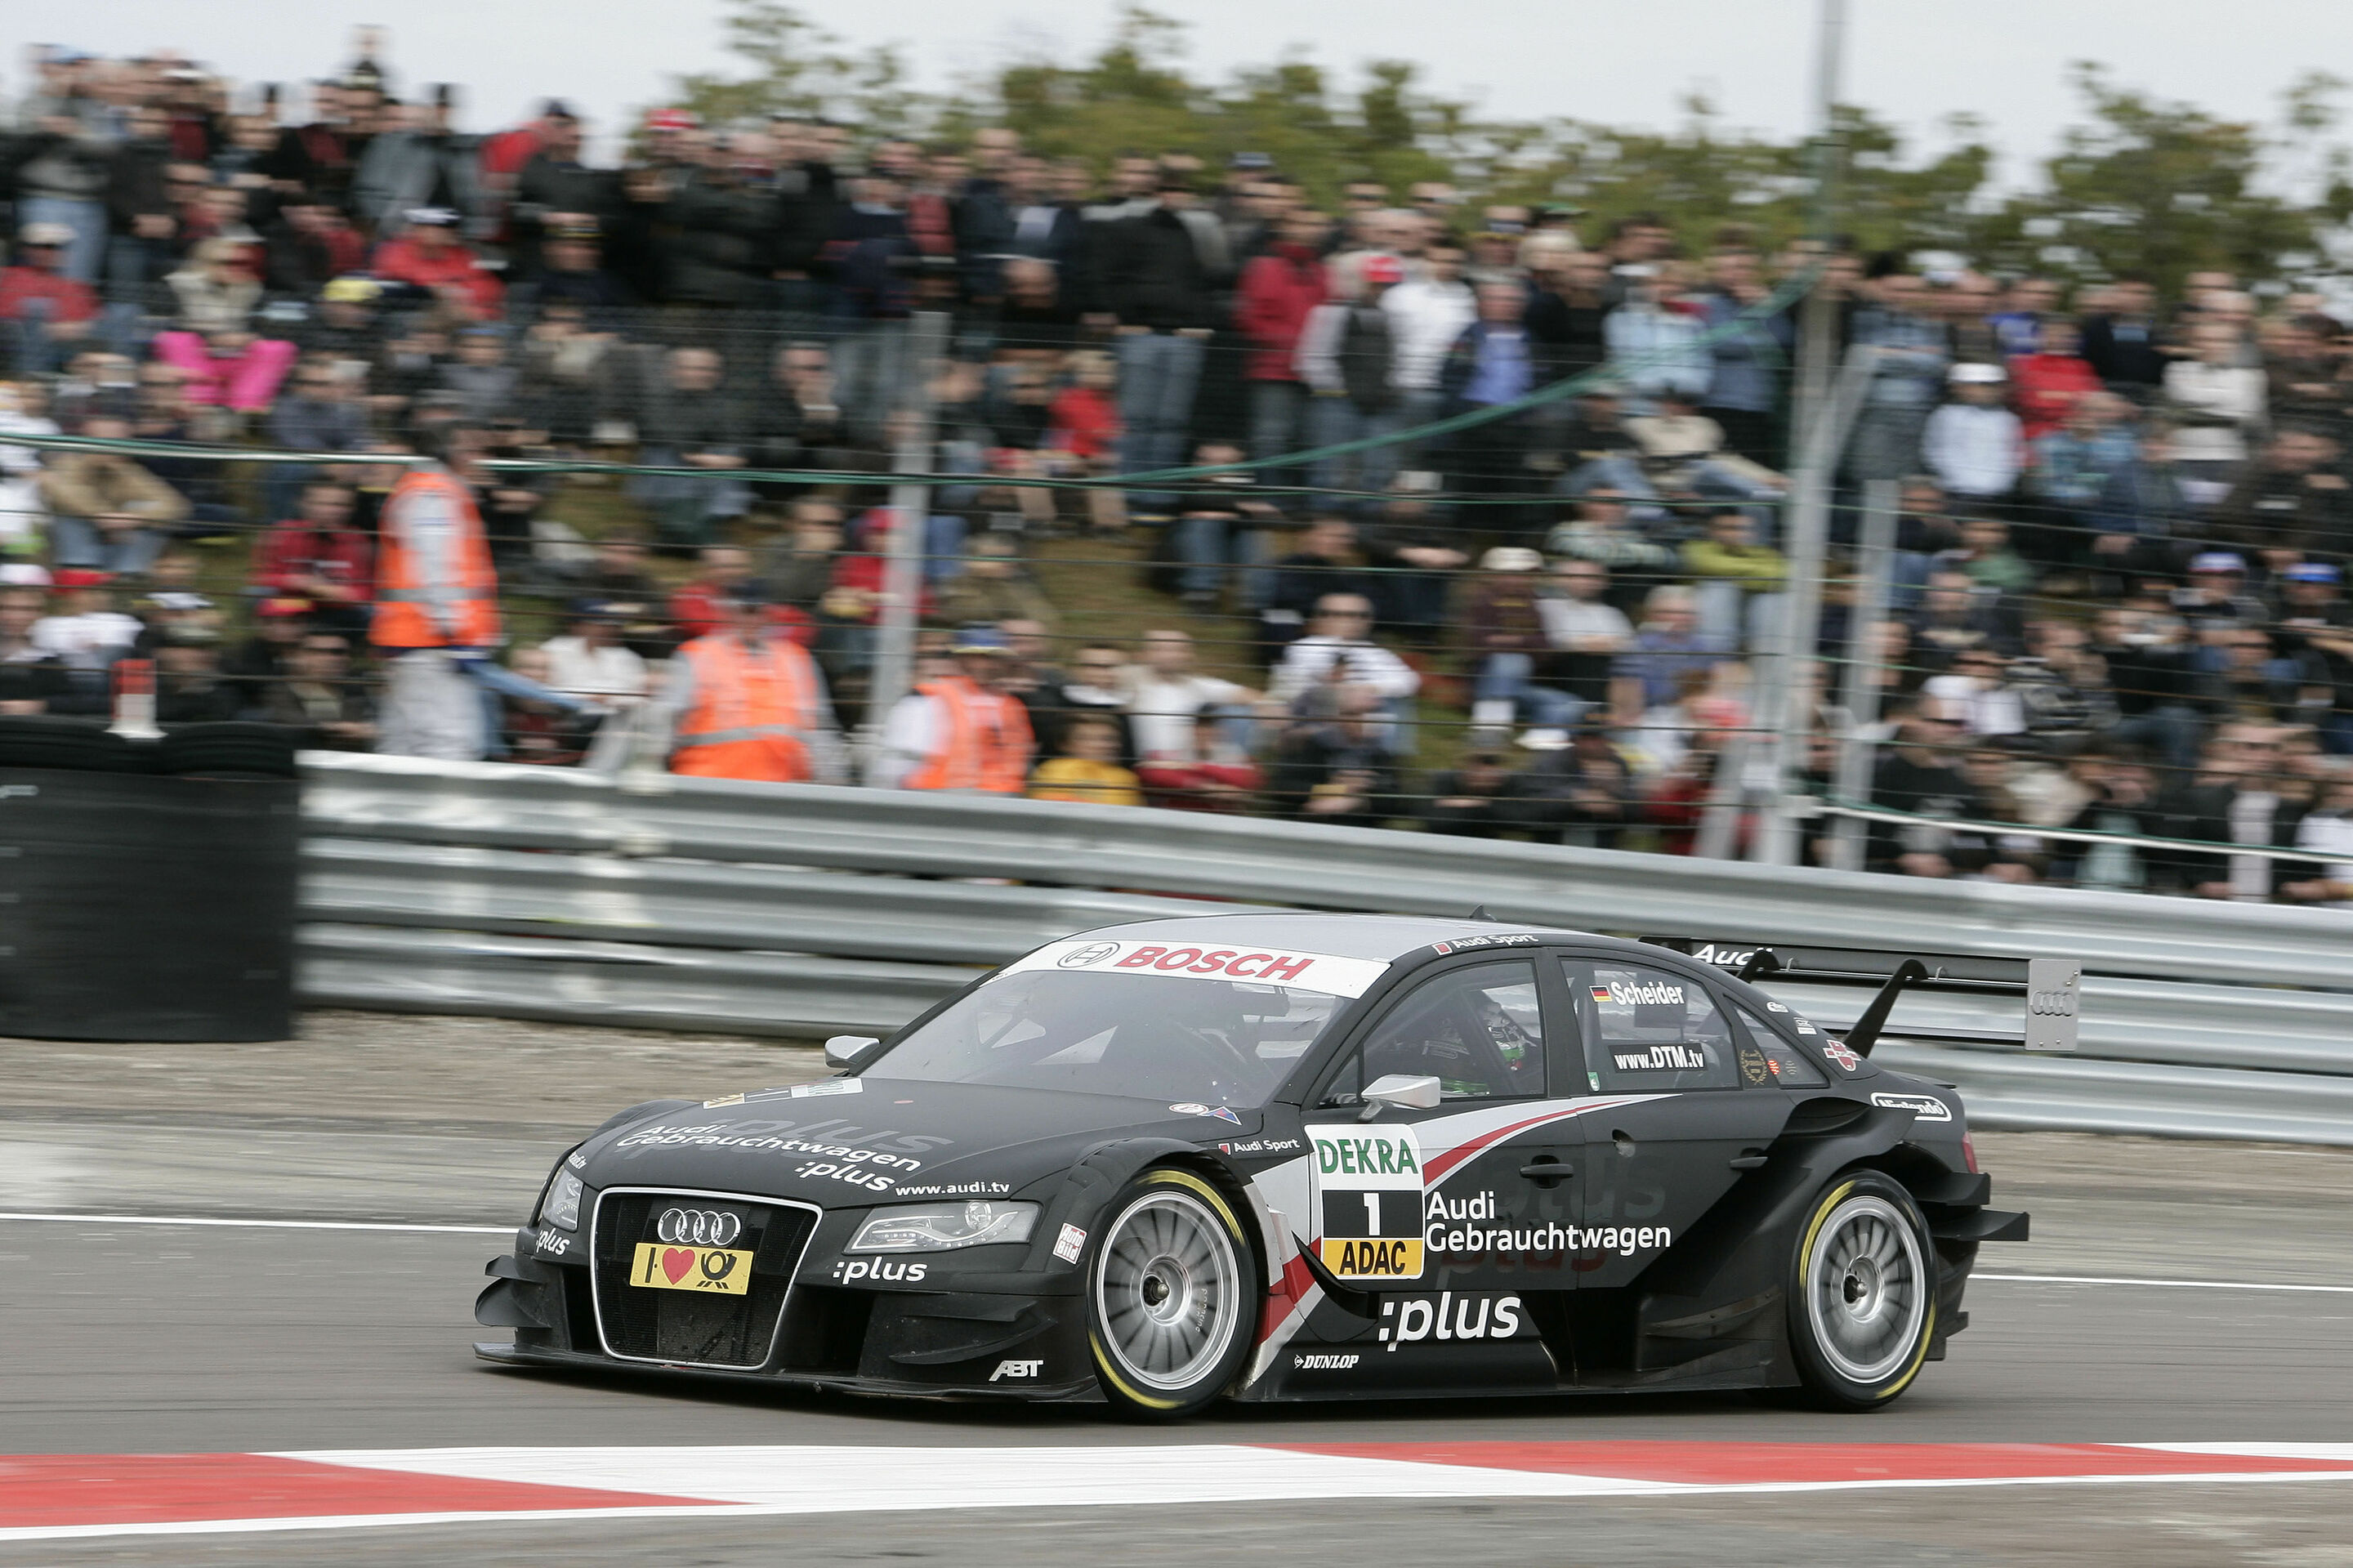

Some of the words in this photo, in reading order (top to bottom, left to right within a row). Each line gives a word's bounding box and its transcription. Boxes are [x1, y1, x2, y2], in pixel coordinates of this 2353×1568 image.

[1451, 936, 1491, 948] Audi
[1488, 935, 1539, 945] Sport
[1114, 946, 1315, 981] BOSCH
[1610, 981, 1685, 1006] Scheider
[1614, 1046, 1704, 1070] www.DTM.tv
[632, 1124, 727, 1137] Audi
[616, 1133, 922, 1172] Gebrauchtwagen
[1235, 1141, 1263, 1153] Audi
[1264, 1138, 1301, 1152] Sport
[1315, 1138, 1419, 1175] DEKRA
[793, 1160, 896, 1192] :plus
[895, 1182, 1011, 1196] www.audi.tv
[1363, 1192, 1381, 1236] 1
[1425, 1191, 1497, 1221] Audi
[1061, 1226, 1085, 1245] Auto
[1425, 1222, 1672, 1257] Gebrauchtwagen
[1056, 1239, 1080, 1261] Bild
[1341, 1240, 1407, 1275] ADAC
[832, 1256, 928, 1284] :plus
[1377, 1291, 1522, 1352] :plus
[989, 1360, 1044, 1382] ABT
[1302, 1355, 1360, 1369] DUNLOP
